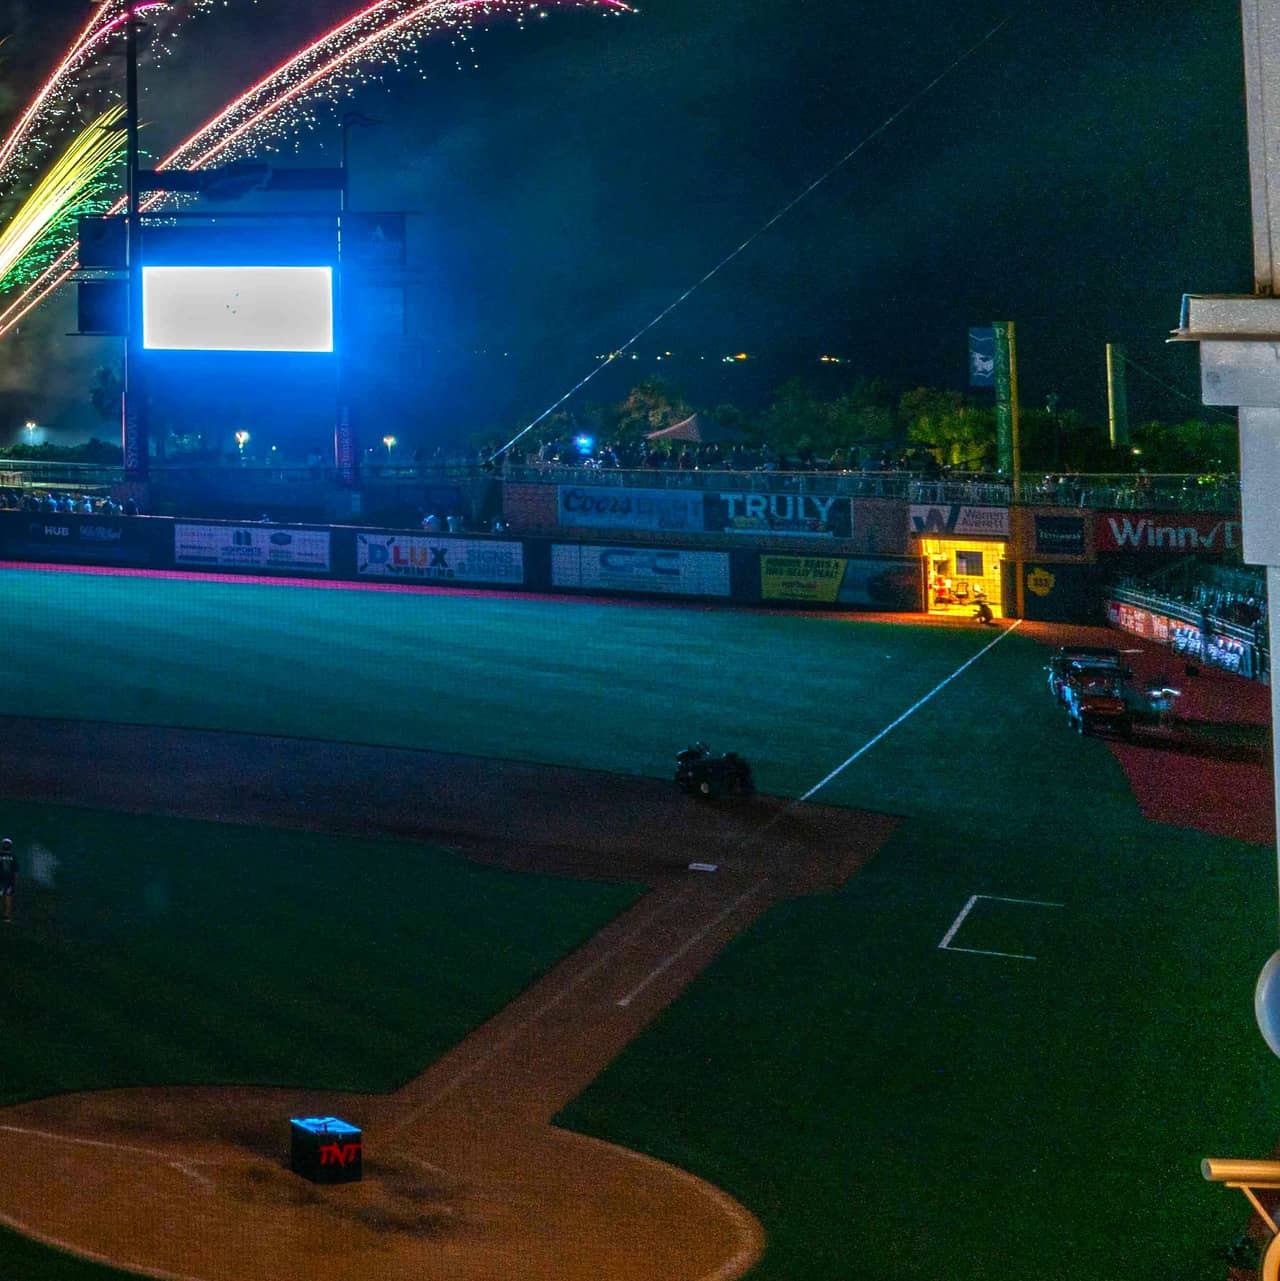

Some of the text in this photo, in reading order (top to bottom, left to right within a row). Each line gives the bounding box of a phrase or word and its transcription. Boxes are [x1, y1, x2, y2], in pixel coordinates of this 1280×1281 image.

[720, 493, 837, 523] TRULY
[44, 525, 70, 536] HUB
[1108, 518, 1200, 548] Winn
[368, 543, 515, 568] DLUX SIGNS
[320, 1142, 362, 1167] TNT
